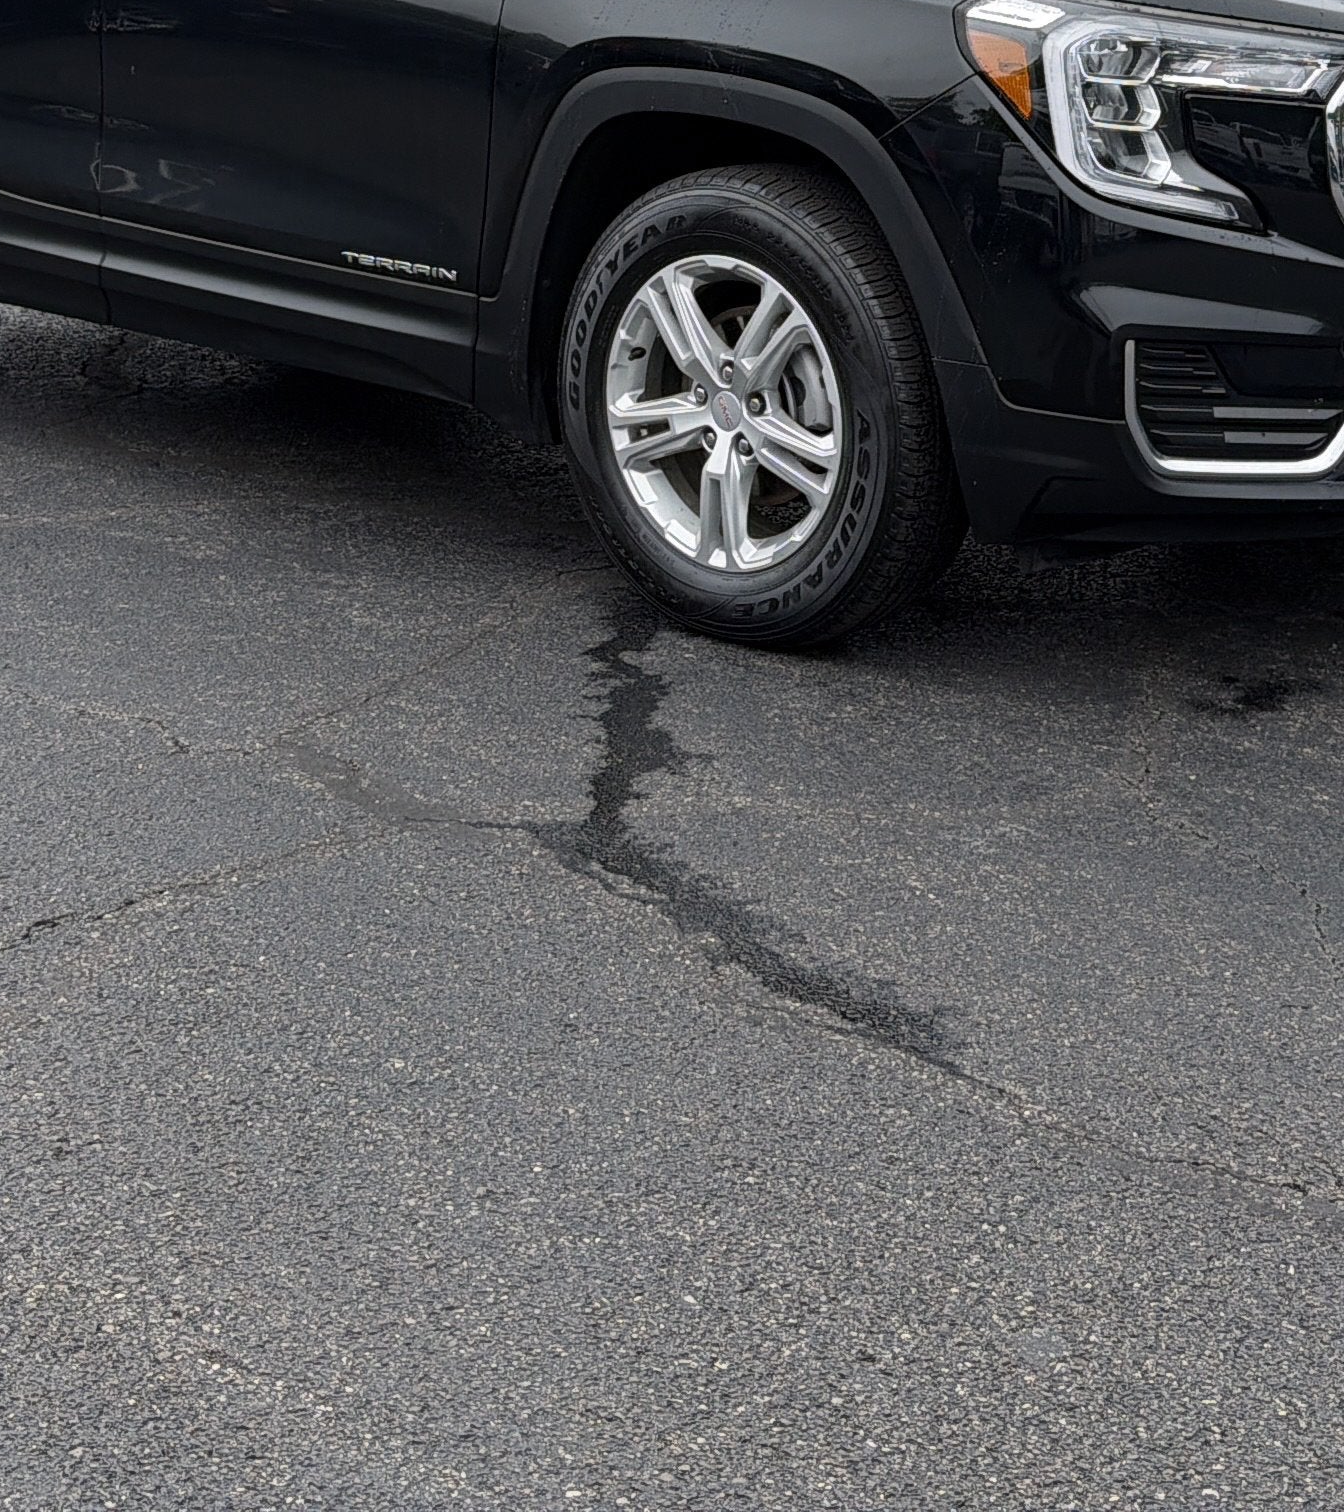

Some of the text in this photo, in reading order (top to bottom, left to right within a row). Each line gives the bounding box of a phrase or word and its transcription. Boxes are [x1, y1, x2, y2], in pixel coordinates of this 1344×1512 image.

[341, 251, 457, 281] TERRAIN
[568, 214, 688, 412] GOODYEAR
[732, 409, 871, 618] ASSURANCE
